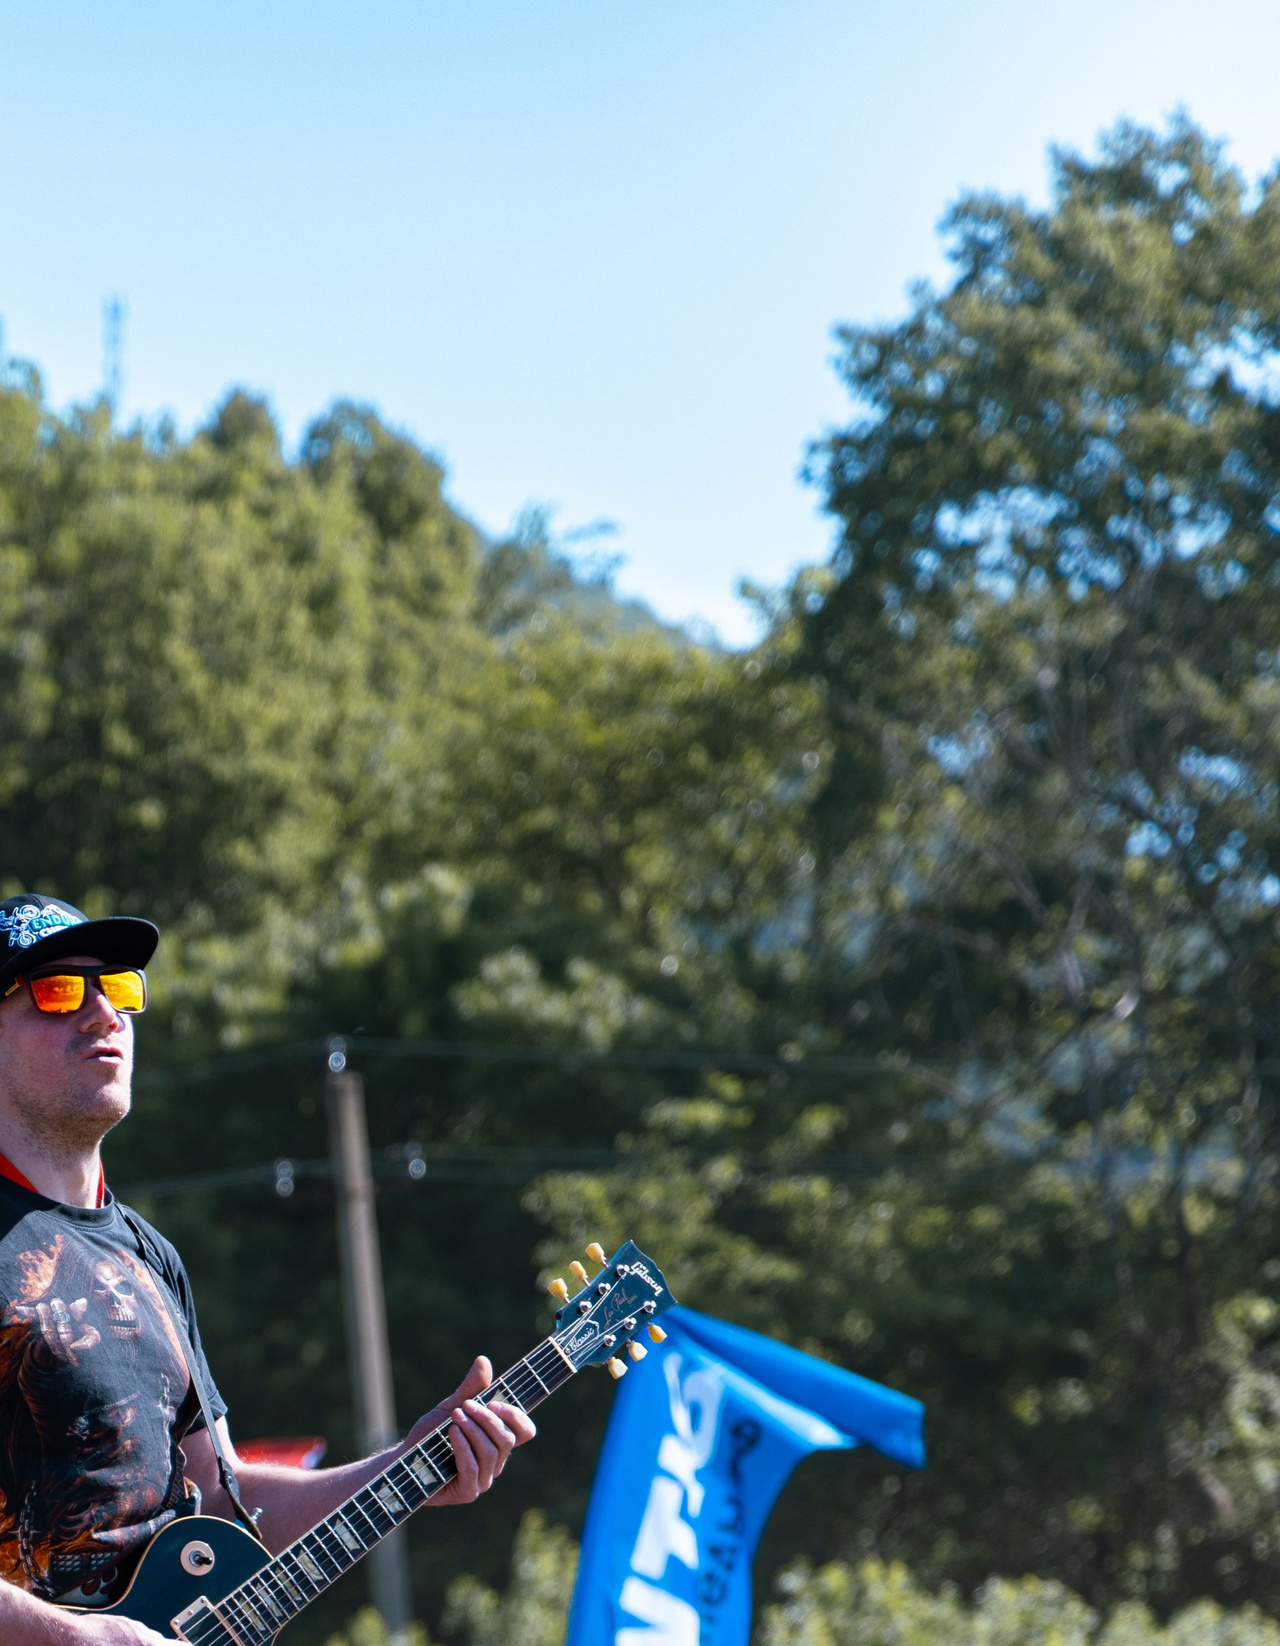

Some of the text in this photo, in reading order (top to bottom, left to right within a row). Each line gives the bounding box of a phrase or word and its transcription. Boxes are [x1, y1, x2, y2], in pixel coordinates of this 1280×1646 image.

[32, 914, 83, 929] ENDUR
[628, 1261, 663, 1297] Gibson
[570, 1327, 595, 1351] Classic
